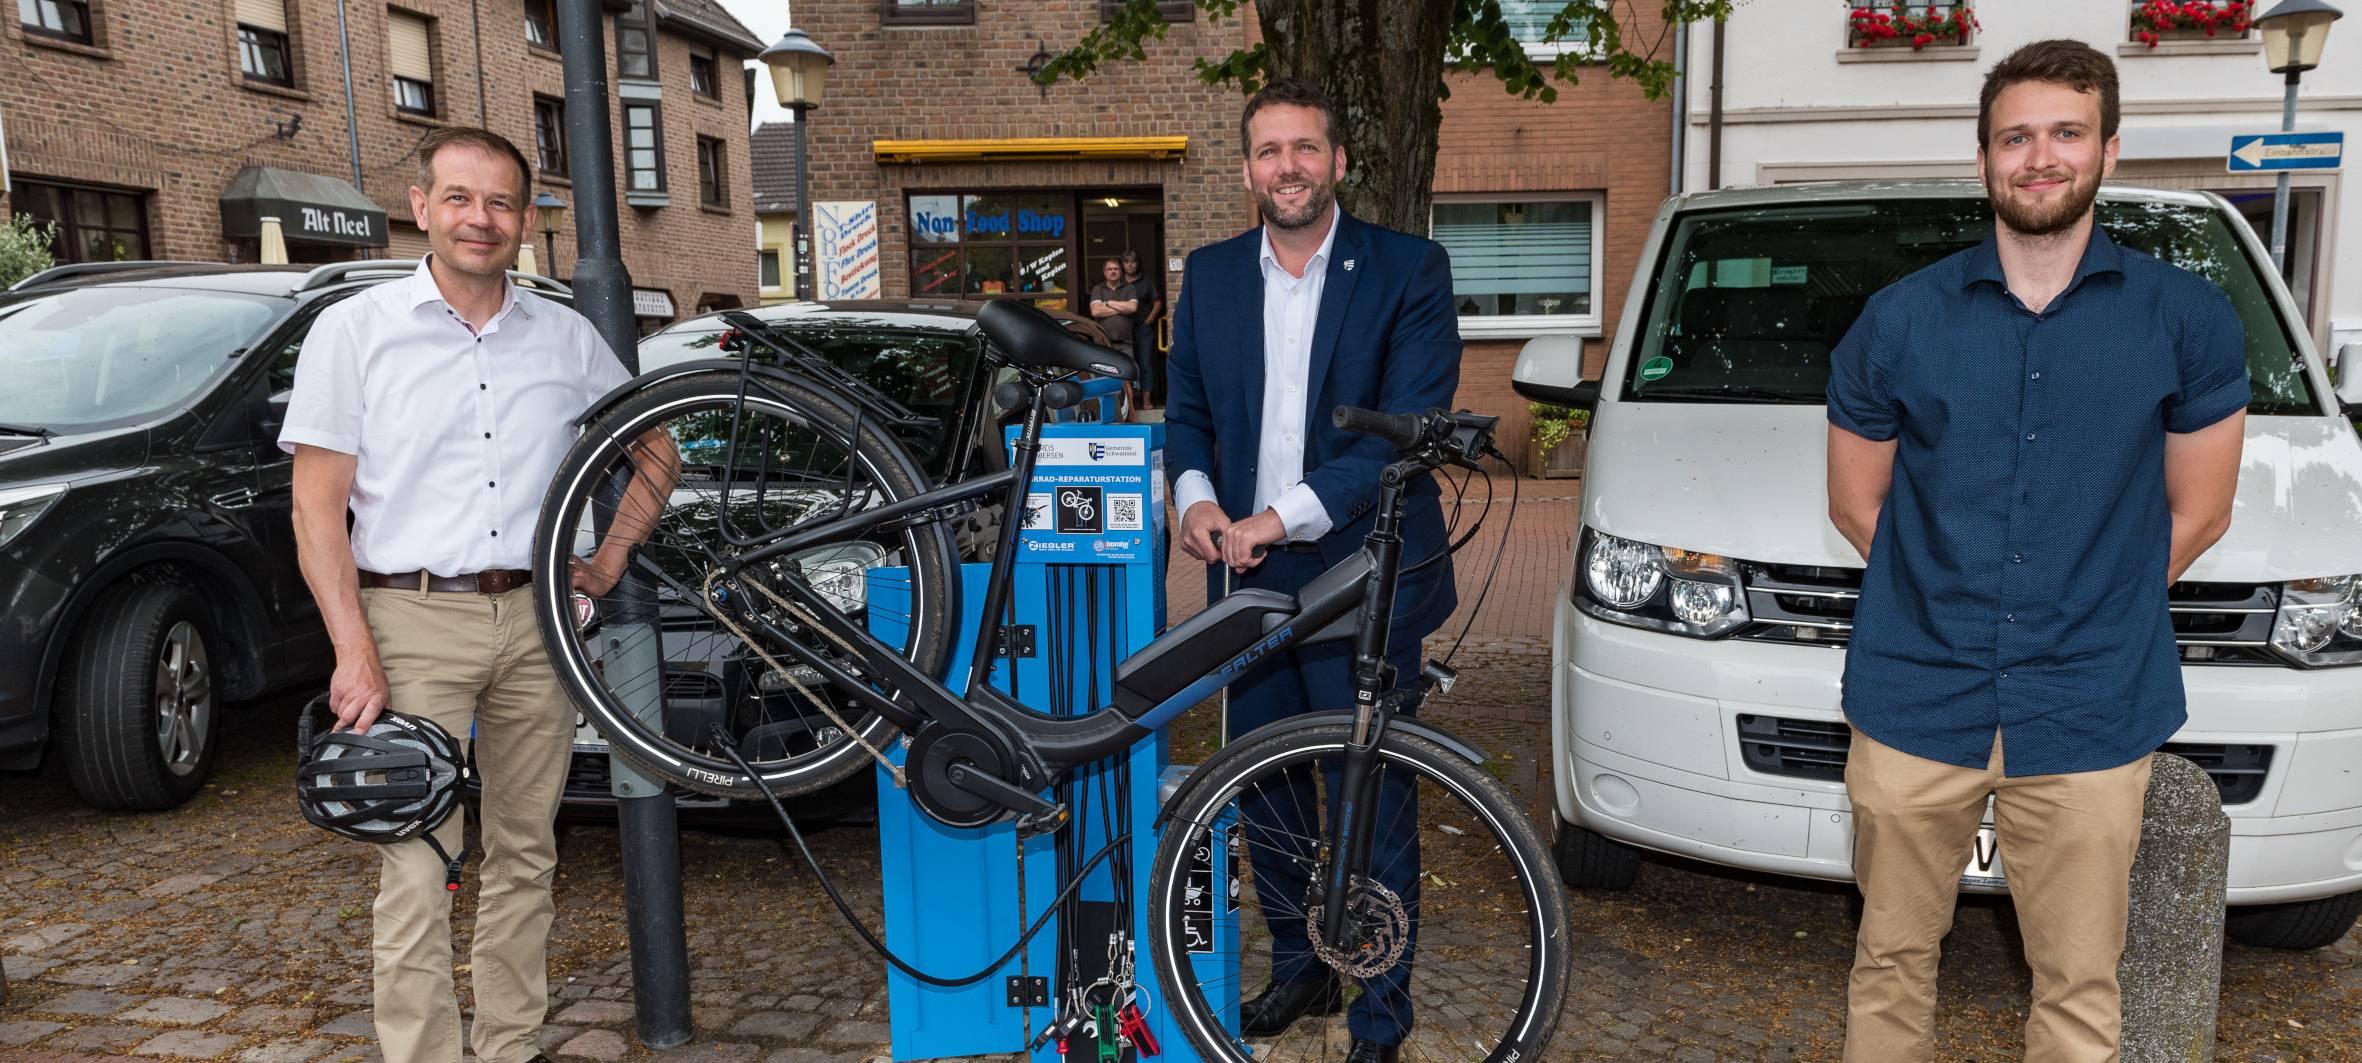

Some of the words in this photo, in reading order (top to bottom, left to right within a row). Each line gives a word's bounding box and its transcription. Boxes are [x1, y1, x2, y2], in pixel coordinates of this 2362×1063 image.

[301, 207, 330, 233] Alt
[333, 211, 371, 237] Neel
[916, 211, 954, 234] Non
[966, 210, 1010, 234] Food
[1018, 210, 1065, 237] Shop
[857, 224, 876, 244] Druck
[857, 240, 877, 258] Druck
[1038, 247, 1065, 266] Kopien
[1035, 262, 1051, 276] und
[1041, 262, 1067, 282] Kopien
[1031, 475, 1141, 483] RRAD-REPARATURSTATION
[1028, 541, 1075, 551] ZIEGLER
[388, 716, 418, 731] uvex
[686, 767, 734, 787] PIRELLI
[395, 820, 423, 837] uvex
